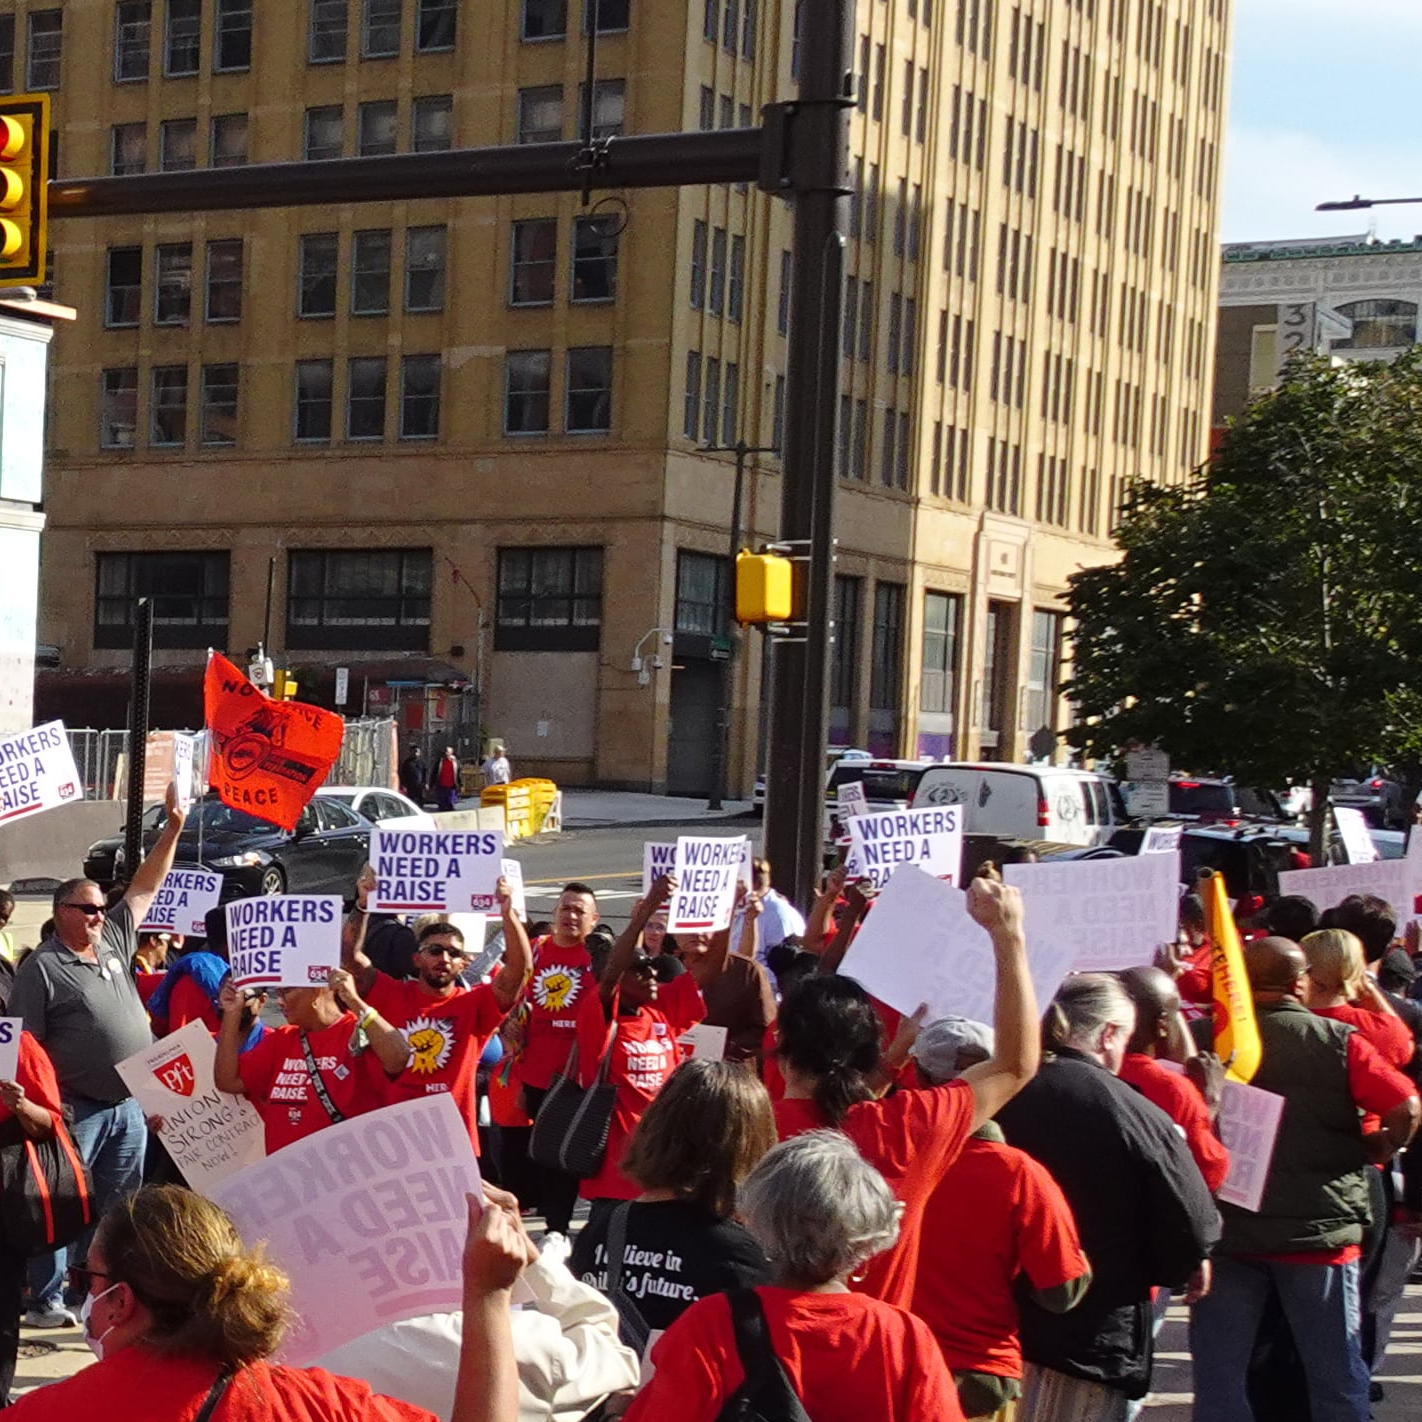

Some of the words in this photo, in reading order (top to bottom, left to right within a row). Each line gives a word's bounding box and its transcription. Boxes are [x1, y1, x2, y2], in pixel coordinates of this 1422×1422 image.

[221, 680, 253, 697] NO
[34, 757, 45, 776] A
[3, 781, 40, 809] AISE
[224, 782, 278, 805] PEACE
[859, 811, 956, 840] WORKERS
[379, 834, 496, 855] WORKERS
[863, 841, 914, 864] NEED
[920, 839, 931, 860] A
[378, 857, 440, 878] NEED
[446, 858, 461, 878] A
[165, 873, 217, 893] RKERS
[376, 880, 446, 902] RAISE
[680, 869, 720, 893] NEED
[721, 869, 729, 892] A
[177, 891, 188, 907] A
[676, 896, 718, 919] RAISE
[145, 907, 176, 924] AISE
[230, 900, 334, 926] WORKERS
[231, 926, 275, 949] NEED
[281, 925, 297, 948] A
[233, 951, 281, 975] RAISE
[284, 1056, 337, 1072] WORERS
[161, 1061, 194, 1092] pft
[205, 1116, 261, 1150] CONTRAC
[593, 1244, 604, 1265] I
[665, 1249, 683, 1272] in
[636, 1277, 700, 1303] future.
